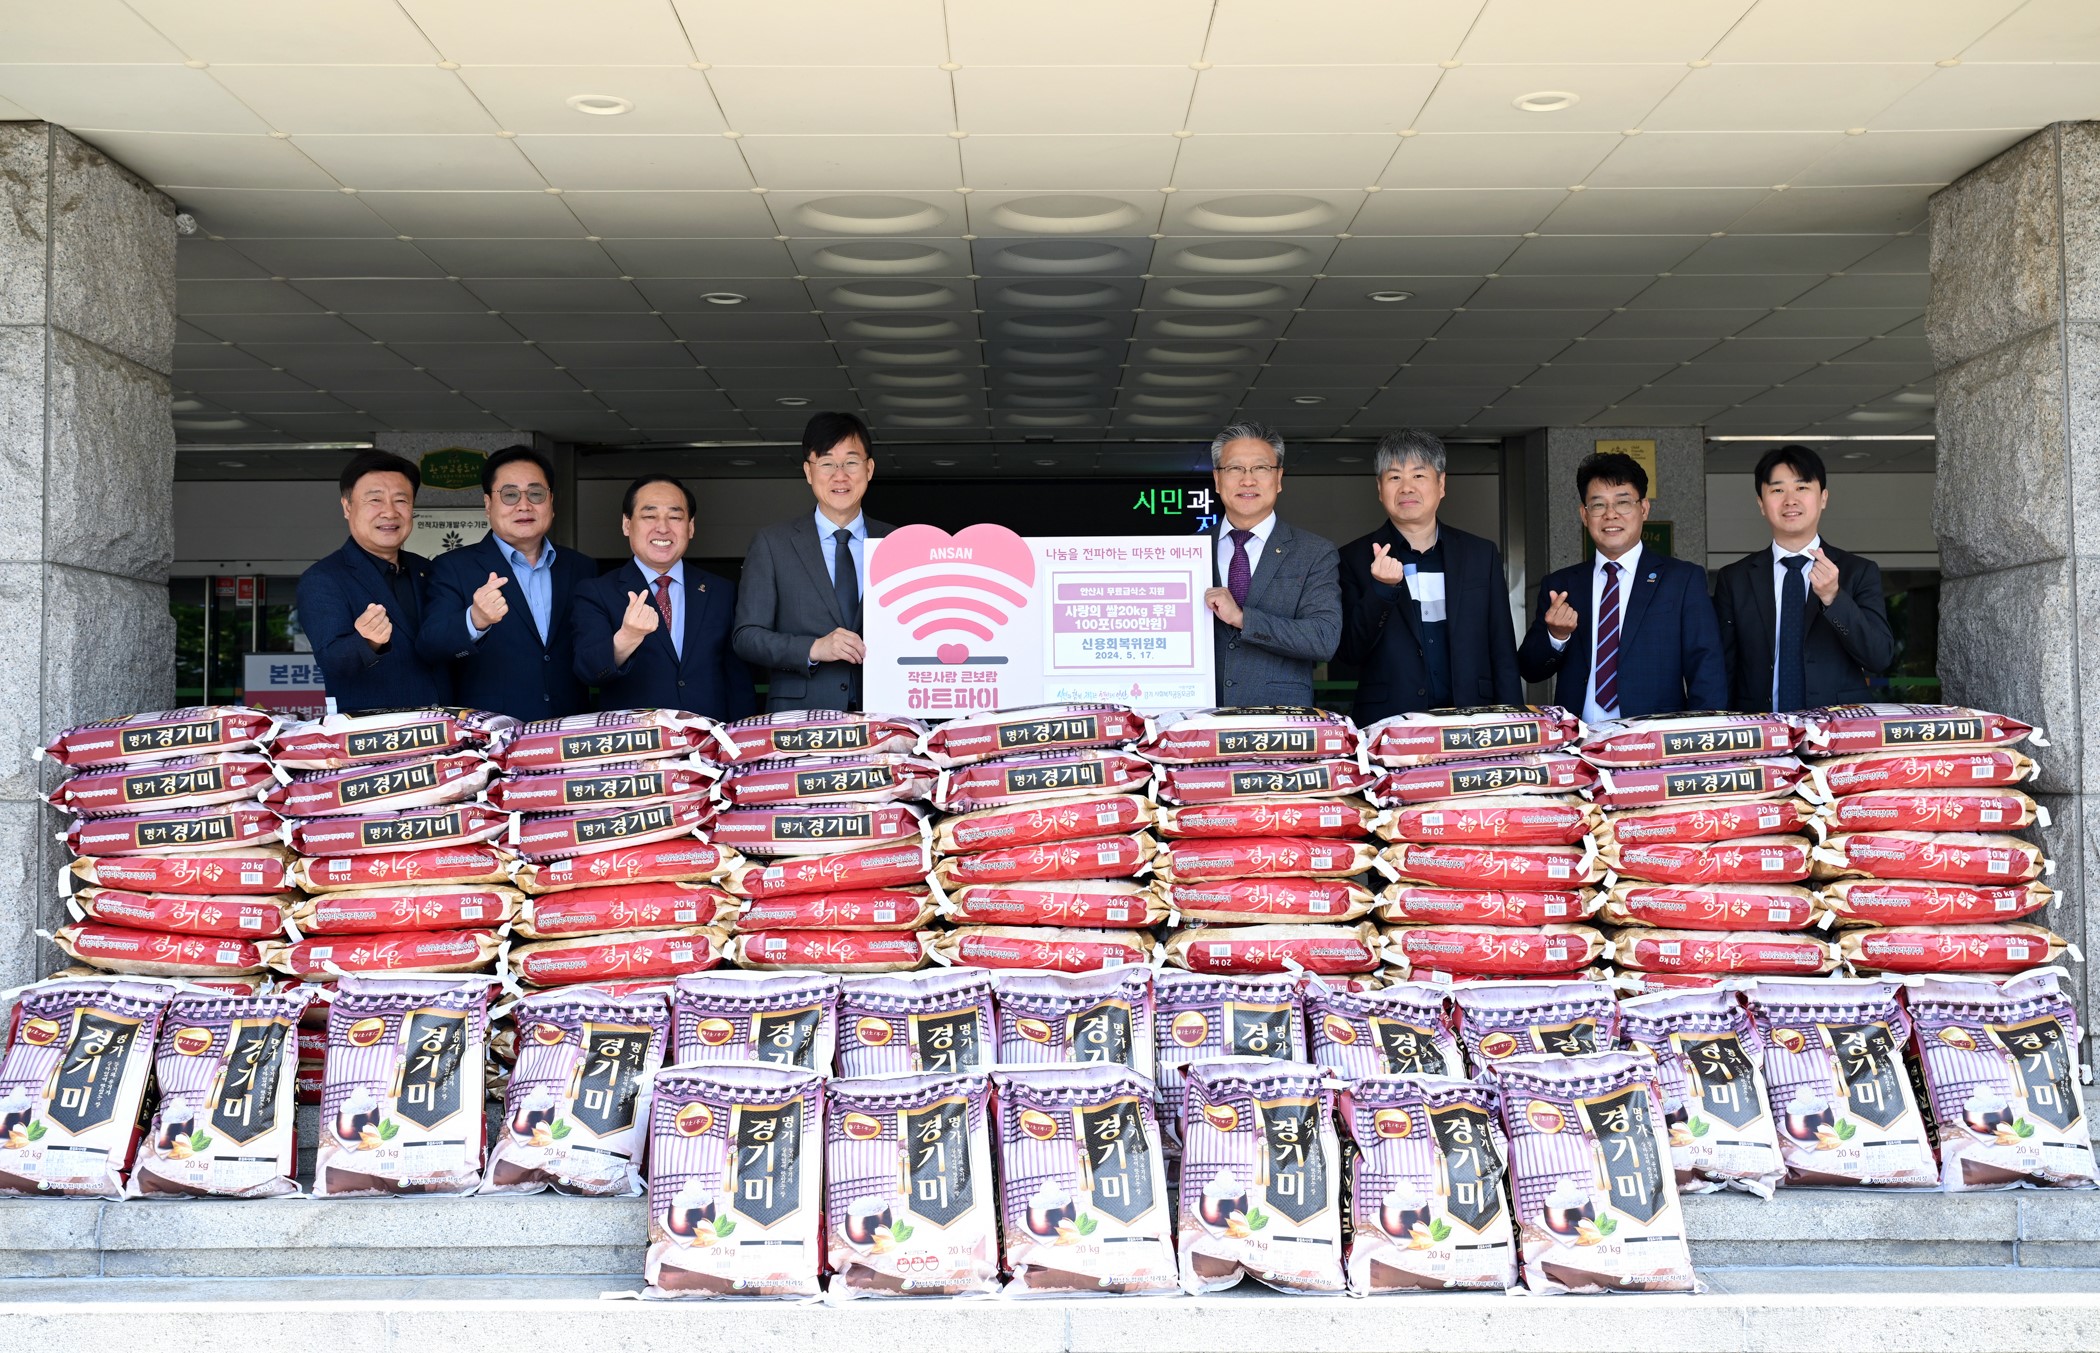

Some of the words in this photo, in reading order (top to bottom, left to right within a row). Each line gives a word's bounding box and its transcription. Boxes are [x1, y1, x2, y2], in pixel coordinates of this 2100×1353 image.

[1133, 488, 1214, 514] 시민과
[418, 521, 488, 530] 인적자원개발우수기관
[1641, 532, 1660, 542] 014
[930, 548, 972, 560] ANSAN
[1046, 548, 1078, 560] 나눔을
[1083, 548, 1128, 560] 전파하는
[1132, 547, 1166, 560] 따뜻한
[1170, 546, 1203, 559] 에너지
[1080, 587, 1104, 596] 안산시
[1107, 587, 1146, 596] 무료급식소
[1149, 587, 1165, 596] 지원
[1065, 605, 1100, 617] 사랑의
[1106, 604, 1148, 617] 쌀20kg
[1152, 604, 1176, 617] 후원
[1075, 618, 1167, 631] 100포(500만원)
[1082, 638, 1166, 650] 신용회복위원회
[1096, 652, 1122, 660] 2024.
[1126, 652, 1136, 660] 5.
[1140, 652, 1154, 660] 17.
[908, 671, 957, 683] 작은사랑
[961, 671, 998, 682] 큰보람
[908, 688, 998, 709] 하트파이
[1114, 715, 1123, 724] kg
[128, 734, 151, 747] 명가
[156, 726, 212, 747] 경기미
[355, 736, 376, 749] 명가
[382, 726, 439, 749] 경기미
[780, 734, 802, 746] 명가
[806, 727, 861, 750] 경기미
[1006, 729, 1029, 741] 명가
[1032, 720, 1088, 742] 경기미
[1226, 736, 1247, 749] 명가
[1251, 731, 1307, 751] 경기미
[1450, 734, 1471, 745] 명가
[1474, 725, 1530, 746] 경기미
[1671, 737, 1693, 749] 명가
[1698, 730, 1753, 751] 경기미
[1891, 727, 1914, 739] 명가
[1918, 721, 1975, 741] 경기미
[569, 742, 591, 754] 명가
[595, 731, 652, 754] 경기미
[133, 781, 155, 794] 명가
[160, 771, 214, 795] 경기미
[347, 783, 369, 795] 명가
[374, 769, 429, 794] 경기미
[573, 784, 595, 796] 명가
[600, 776, 655, 798] 경기미
[804, 777, 826, 790] 명가
[831, 768, 885, 791] 경기미
[1014, 774, 1037, 786] 명가
[1041, 766, 1095, 787] 경기미
[1241, 777, 1262, 788] 명가
[1267, 770, 1322, 791] 경기미
[1460, 775, 1481, 787] 명가
[1485, 769, 1540, 788] 경기미
[1674, 780, 1696, 791] 명가
[1700, 772, 1755, 793] 경기미
[583, 822, 606, 836] 명가
[610, 808, 665, 835] 경기미
[1912, 799, 1941, 824] 경기
[144, 827, 166, 839] 명가
[171, 820, 225, 841] 경기미
[370, 826, 392, 839] 명가
[397, 817, 452, 840] 경기미
[781, 822, 803, 834] 명가
[808, 817, 862, 836] 경기미
[1027, 810, 1058, 836] 경기
[253, 862, 263, 871] kg
[1247, 847, 1275, 872] 경기
[1476, 852, 1507, 878] 경기
[171, 860, 200, 886] 경기
[392, 898, 419, 924] 경기
[686, 900, 695, 909] kg
[809, 900, 837, 924] 경기
[2017, 938, 2028, 946] kg
[601, 946, 630, 972] 경기
[109, 1034, 129, 1058] 명가
[266, 1036, 280, 1061] 명가
[767, 1023, 795, 1067] 경기
[927, 1024, 958, 1073] 경기
[1083, 1015, 1110, 1062] 경기
[1872, 1038, 1890, 1052] 명가
[2044, 1030, 2062, 1053] 명가
[630, 1041, 642, 1065] 명가
[1390, 1032, 1422, 1073] 경기
[61, 1025, 111, 1117] 경기미
[408, 1026, 445, 1111] 경기미
[585, 1038, 622, 1119] 경기미
[1840, 1032, 1885, 1111] 경기미
[2010, 1033, 2062, 1114] 경기미
[223, 1035, 268, 1126] 경기미
[781, 1116, 795, 1144] 명가
[949, 1117, 961, 1144] 명가
[1305, 1119, 1317, 1140] 명가
[1633, 1107, 1648, 1137] 명가
[1476, 1124, 1490, 1151] 명가
[20, 1150, 31, 1158] 20
[32, 1150, 42, 1160] kg
[376, 1149, 386, 1157] 20
[389, 1149, 399, 1159] kg
[555, 1149, 566, 1158] kg
[916, 1115, 948, 1208] 경기미
[1094, 1114, 1129, 1205] 경기미
[1272, 1118, 1303, 1205] 경기미
[1600, 1106, 1647, 1205] 경기미
[1690, 1146, 1699, 1155] 20
[1701, 1146, 1712, 1156] kg
[1850, 1149, 1860, 1159] kg
[2016, 1146, 2026, 1154] 20
[2028, 1146, 2039, 1156] kg
[185, 1161, 196, 1169] 20
[198, 1161, 209, 1171] kg
[744, 1118, 777, 1208] 경기미
[1443, 1117, 1484, 1213] 경기미
[724, 1248, 735, 1257] kg
[961, 1246, 971, 1255] kg
[1089, 1246, 1099, 1254] kg
[1257, 1241, 1267, 1250] kg
[1440, 1251, 1450, 1260] kg
[1609, 1246, 1620, 1254] kg
